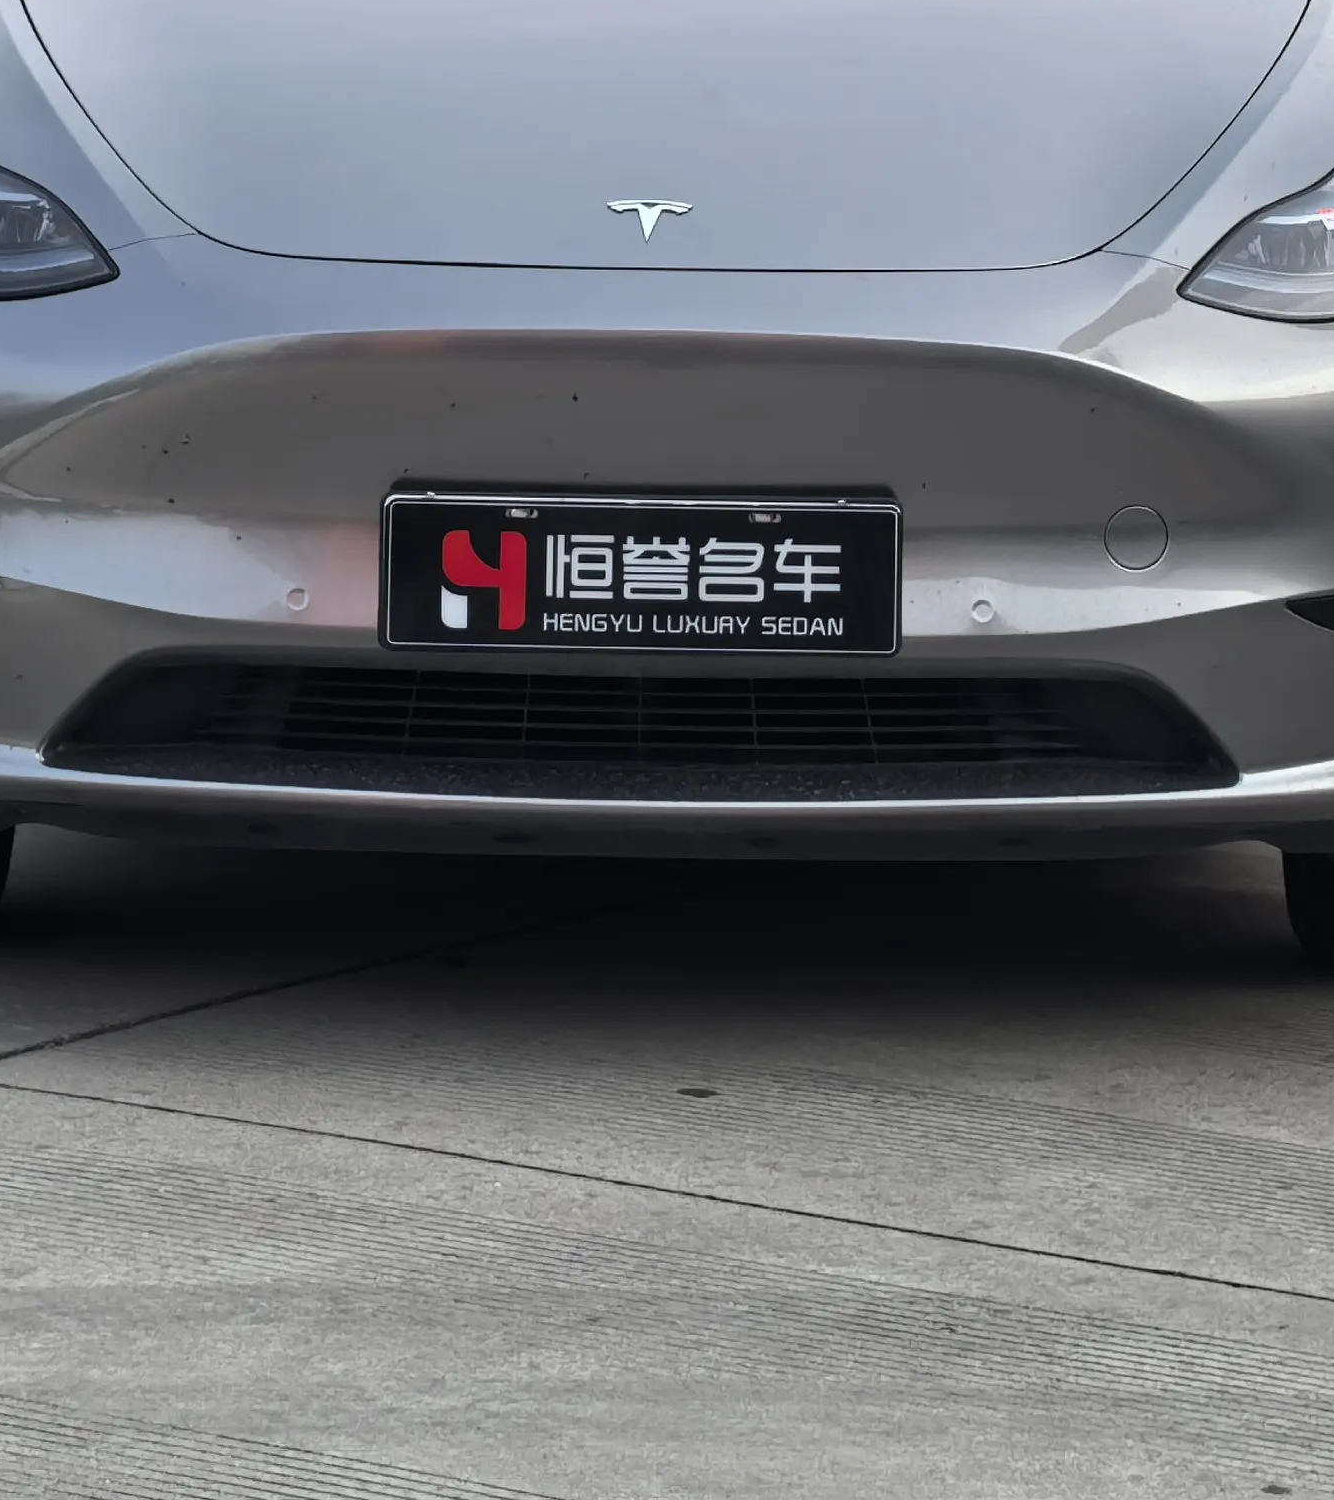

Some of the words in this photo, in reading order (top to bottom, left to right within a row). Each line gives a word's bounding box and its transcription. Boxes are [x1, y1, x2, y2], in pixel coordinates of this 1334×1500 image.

[545, 533, 843, 604] 恒誉名车
[543, 612, 644, 633] HENGYU
[652, 614, 752, 635] LUXURY
[760, 616, 844, 636] SEDAN
